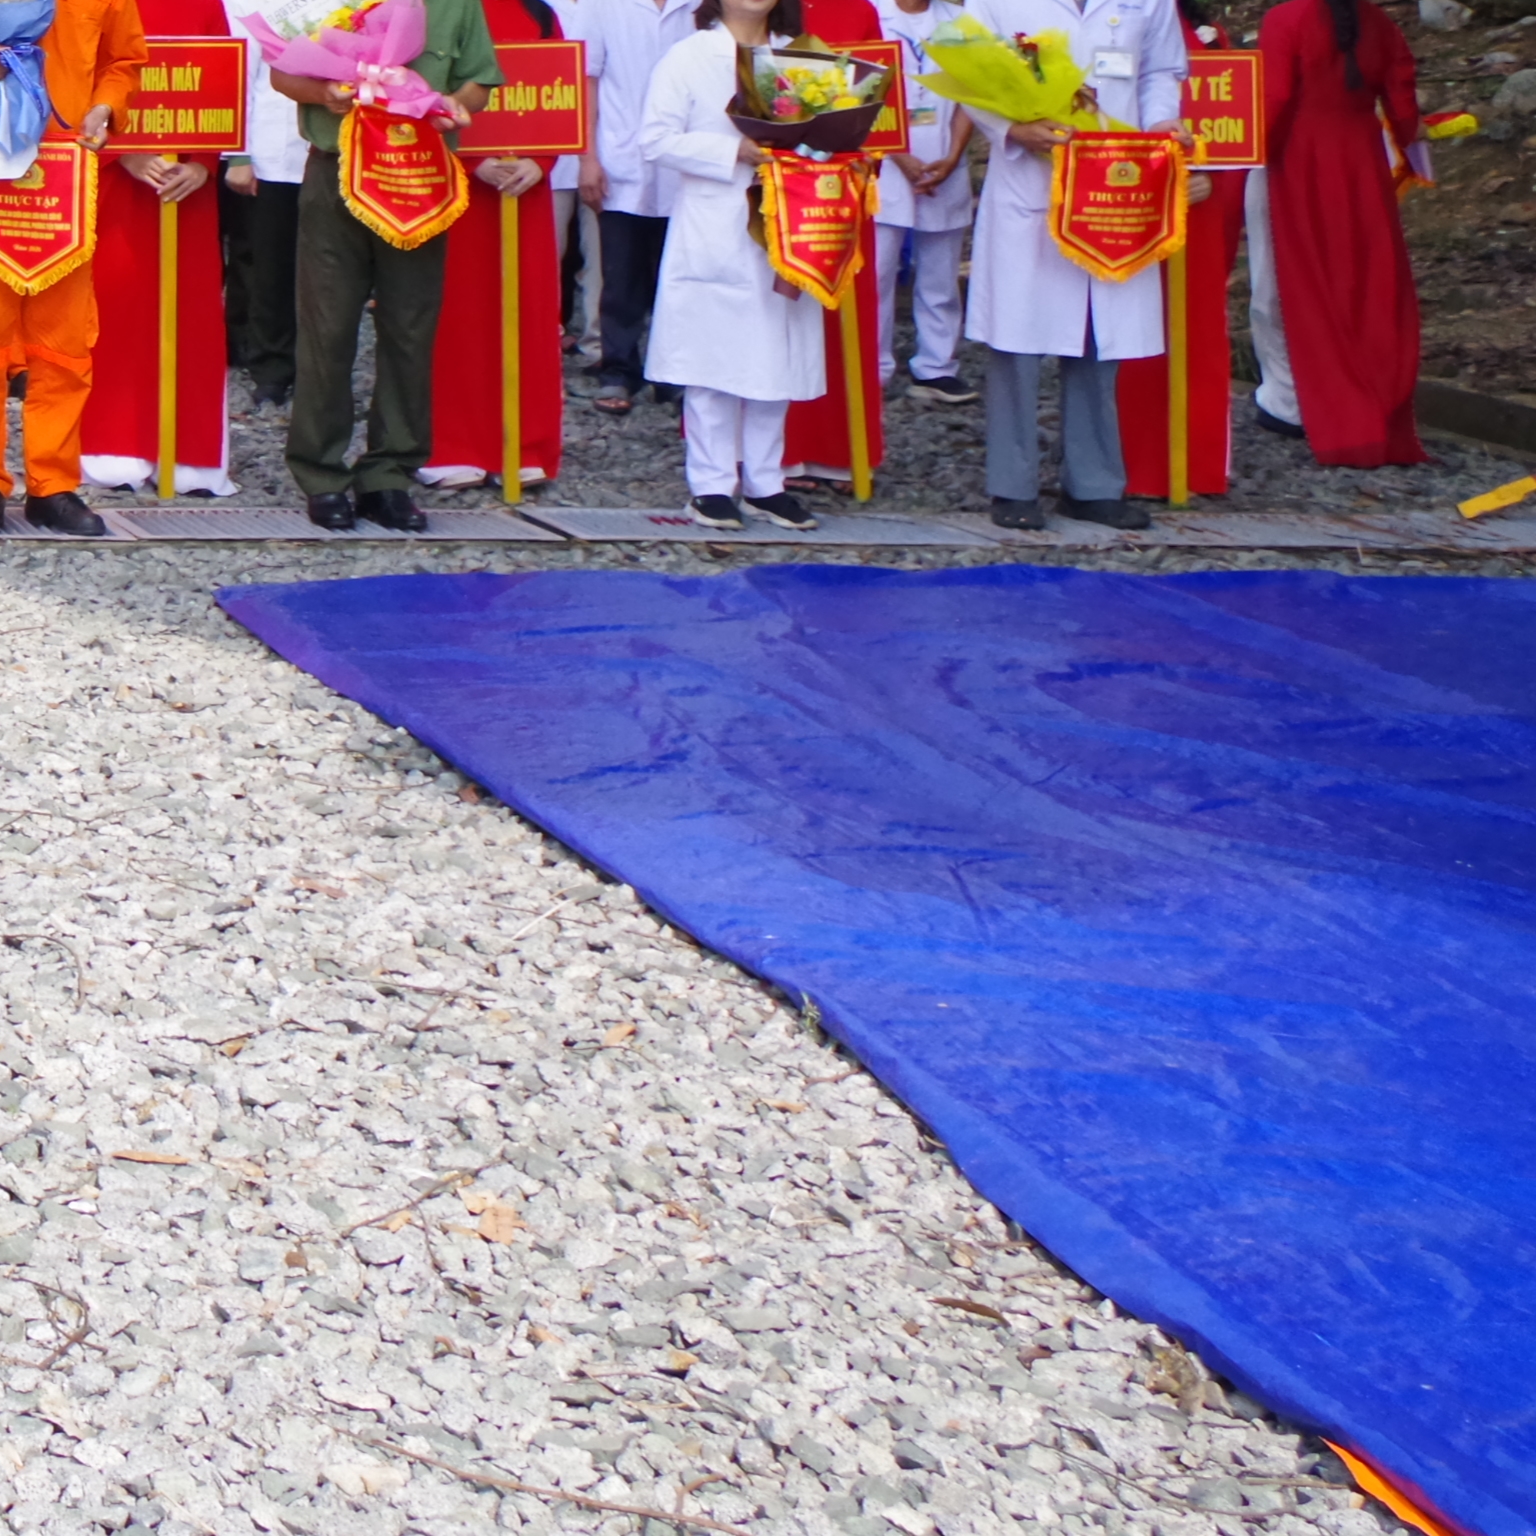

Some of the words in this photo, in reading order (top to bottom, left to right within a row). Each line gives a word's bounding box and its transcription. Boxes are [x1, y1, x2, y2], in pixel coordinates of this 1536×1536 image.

[140, 61, 169, 92] NHÀ
[171, 61, 202, 92] MÁY
[1188, 76, 1202, 102] Y
[1206, 68, 1234, 102] TẾ
[503, 80, 538, 117] HẬU
[142, 103, 174, 140] ĐIỆN
[177, 109, 196, 133] ĐA
[198, 108, 235, 133] NHIM
[1199, 115, 1245, 144] SƠN
[411, 150, 433, 163] TẬP
[34, 195, 60, 209] TẬP
